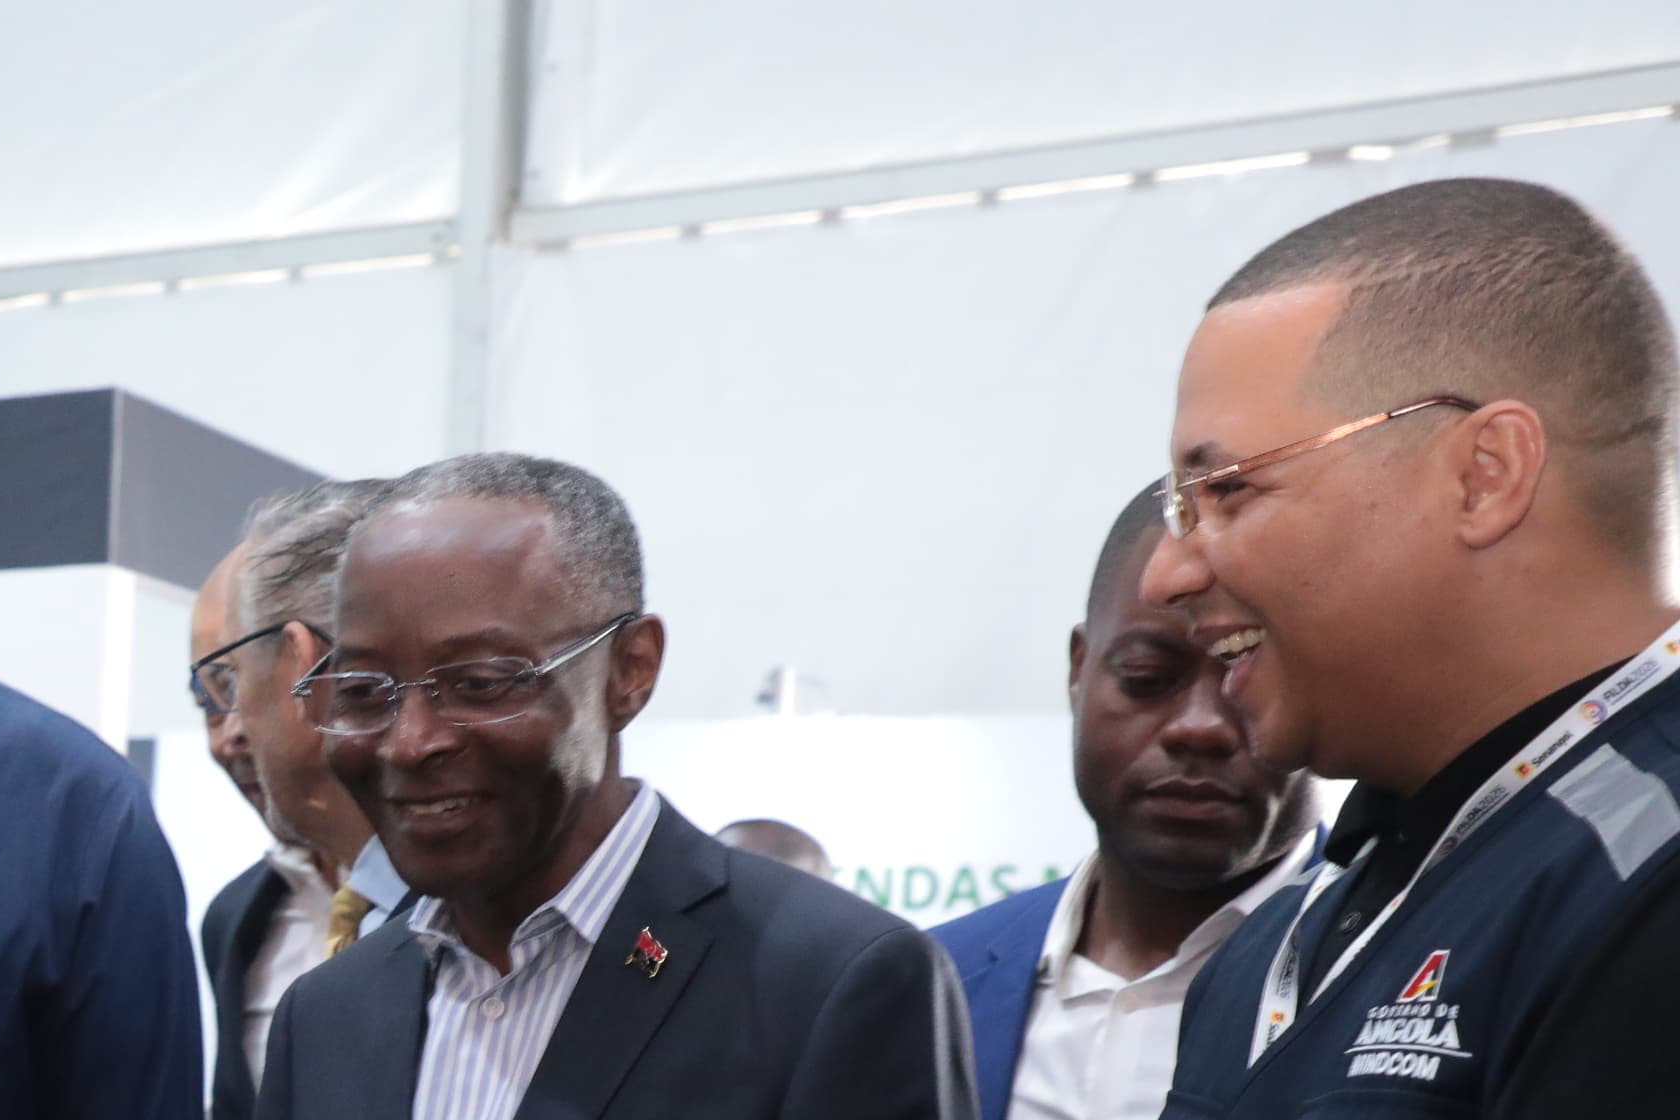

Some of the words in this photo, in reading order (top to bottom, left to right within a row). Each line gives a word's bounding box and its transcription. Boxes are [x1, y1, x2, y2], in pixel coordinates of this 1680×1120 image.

[831, 865, 1017, 910] NDAS
[1434, 1002, 1461, 1019] DE
[1352, 1017, 1461, 1049] ANGOLA
